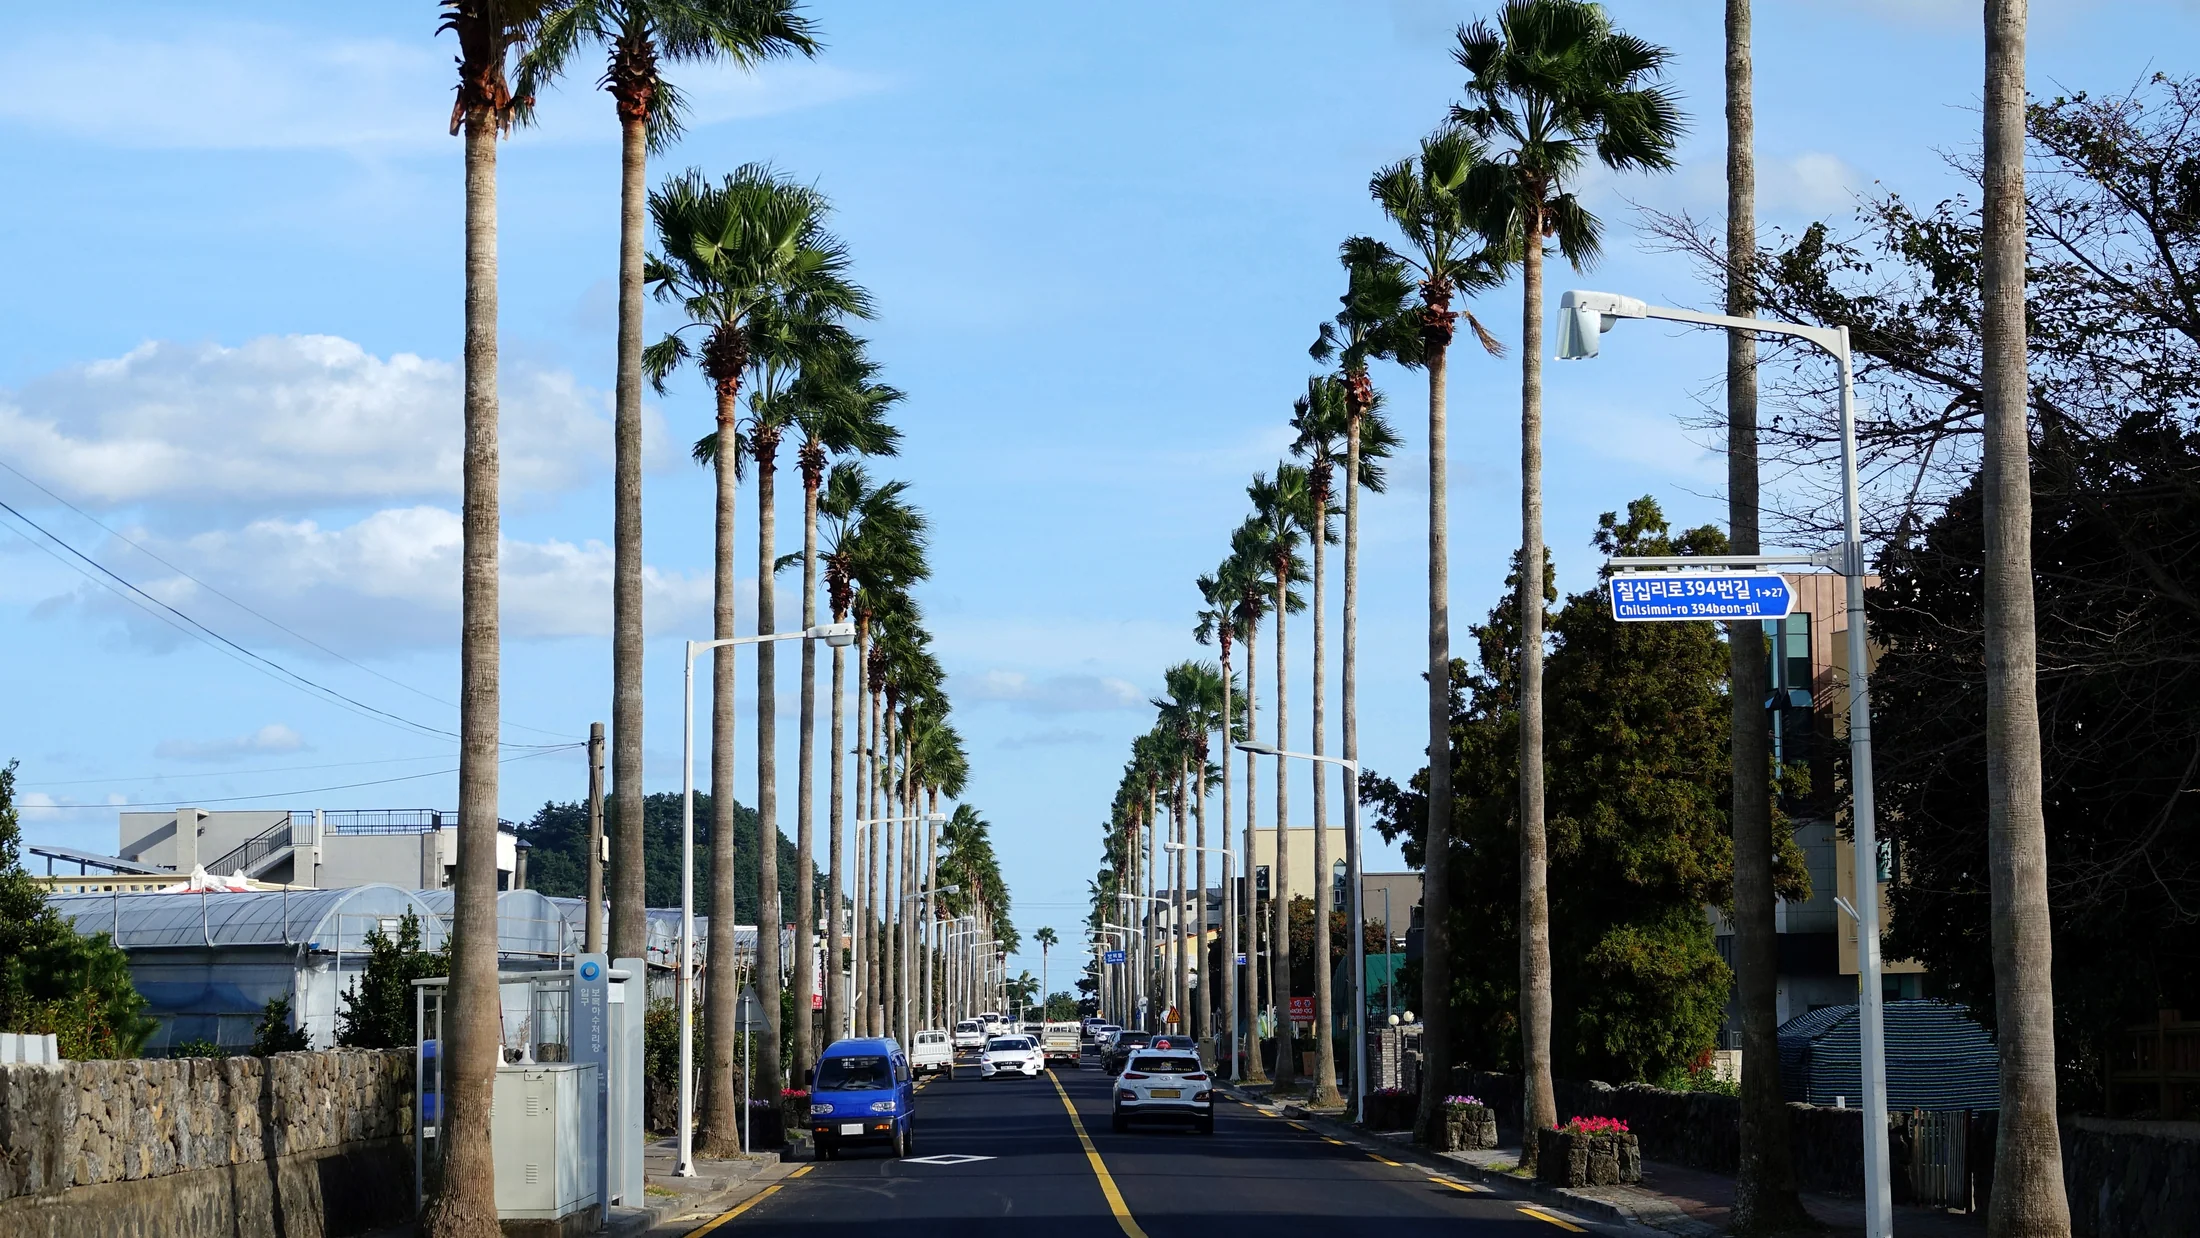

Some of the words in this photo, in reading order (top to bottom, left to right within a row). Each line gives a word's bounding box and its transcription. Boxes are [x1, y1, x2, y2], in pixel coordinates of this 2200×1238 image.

[1617, 580, 1751, 602] 칠십리로394번길
[1619, 604, 1689, 616] Chilsimni-ro
[1691, 602, 1761, 616] 394beon-gil
[581, 988, 589, 1006] 입구
